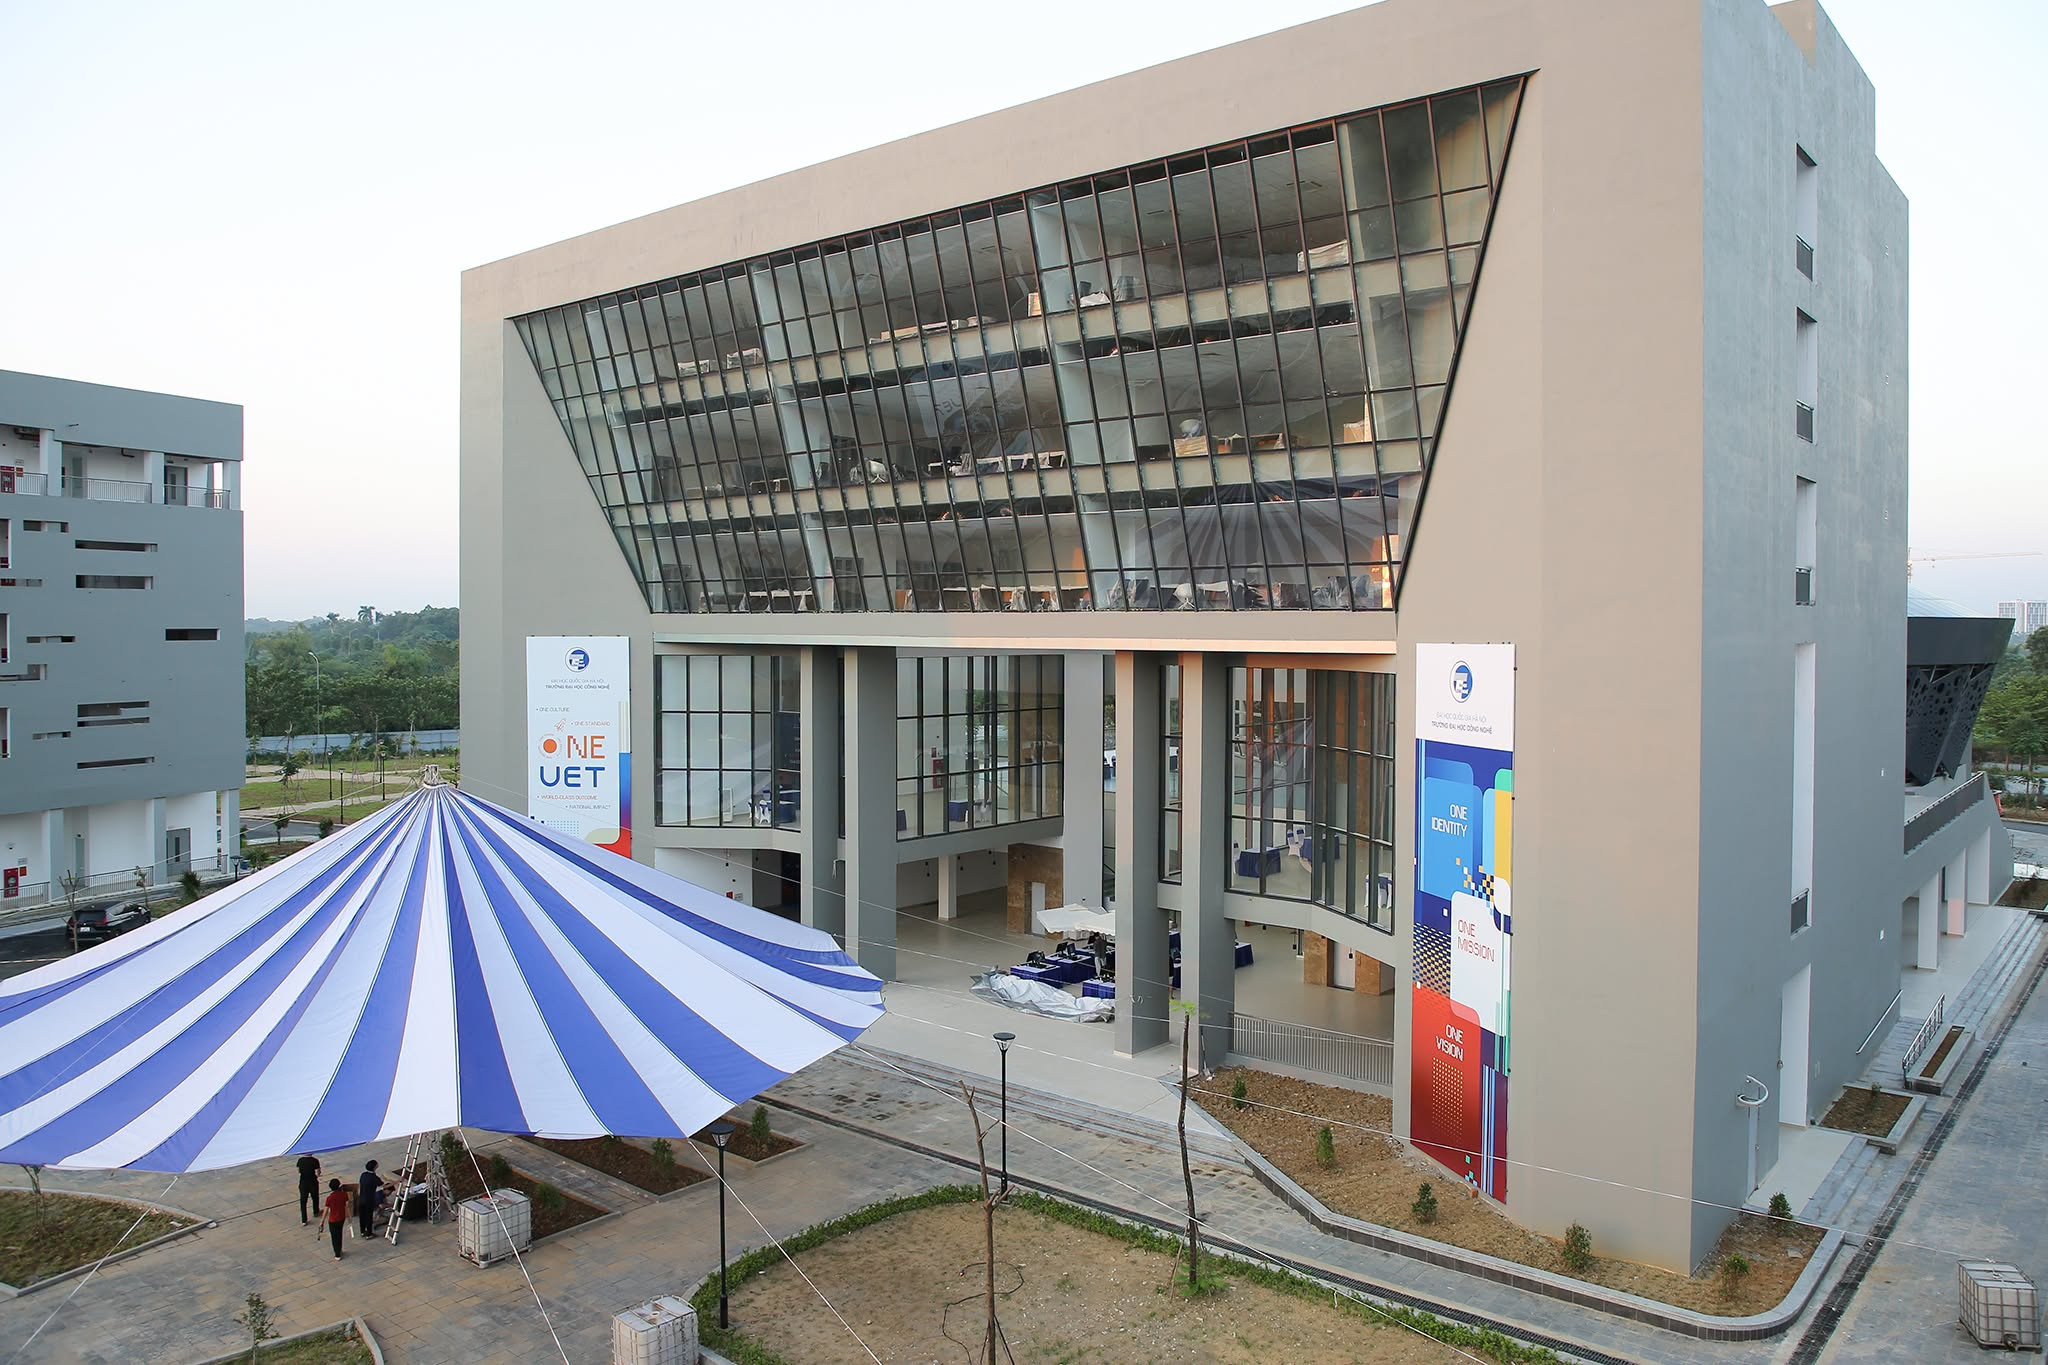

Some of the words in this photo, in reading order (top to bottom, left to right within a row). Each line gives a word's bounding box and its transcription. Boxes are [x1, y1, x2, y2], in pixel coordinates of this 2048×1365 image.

[542, 735, 606, 759] ONE
[540, 766, 605, 788] UET
[1450, 803, 1468, 821] ONE
[1431, 816, 1468, 838] IDENTITY
[1458, 919, 1476, 938] ONE
[1457, 936, 1495, 962] MISSION
[1445, 1024, 1464, 1045] ONE
[1435, 1035, 1464, 1062] VISION
